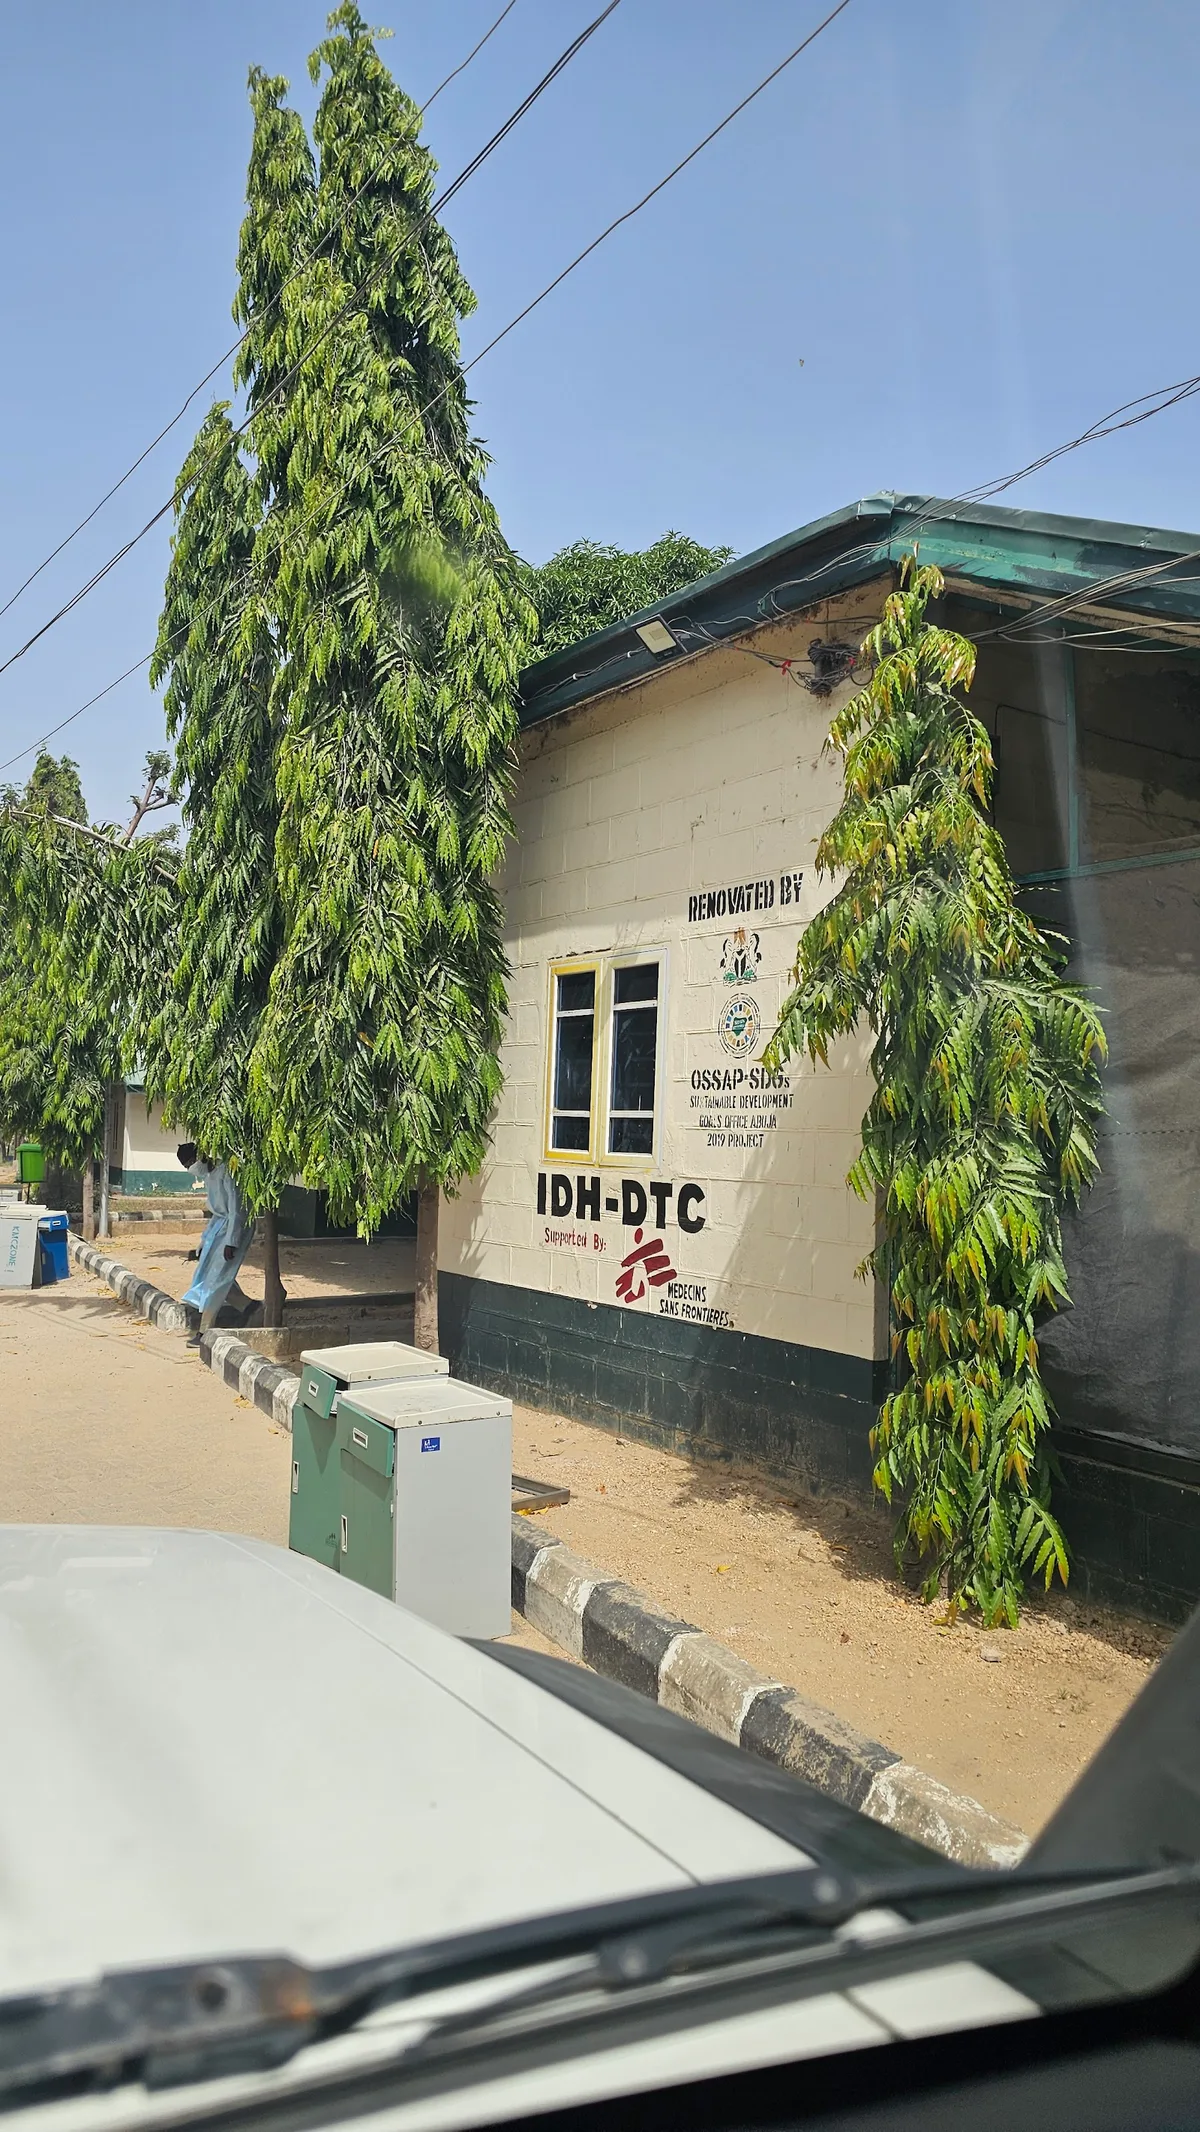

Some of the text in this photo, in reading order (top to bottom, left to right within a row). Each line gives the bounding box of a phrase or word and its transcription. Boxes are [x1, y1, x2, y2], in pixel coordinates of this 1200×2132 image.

[688, 872, 804, 922] RENOVATED BY
[740, 1094, 794, 1109] DEVELOPMENT
[724, 1114, 748, 1129] OFFICE
[750, 1113, 777, 1129] ABUJA
[707, 1133, 764, 1148] 2019 PROJECT
[537, 1172, 706, 1233] IDH-DTC
[544, 1227, 607, 1252] Supported By:
[667, 1282, 707, 1302] MEDECINS
[659, 1298, 730, 1327] SANS FRONTIERES
